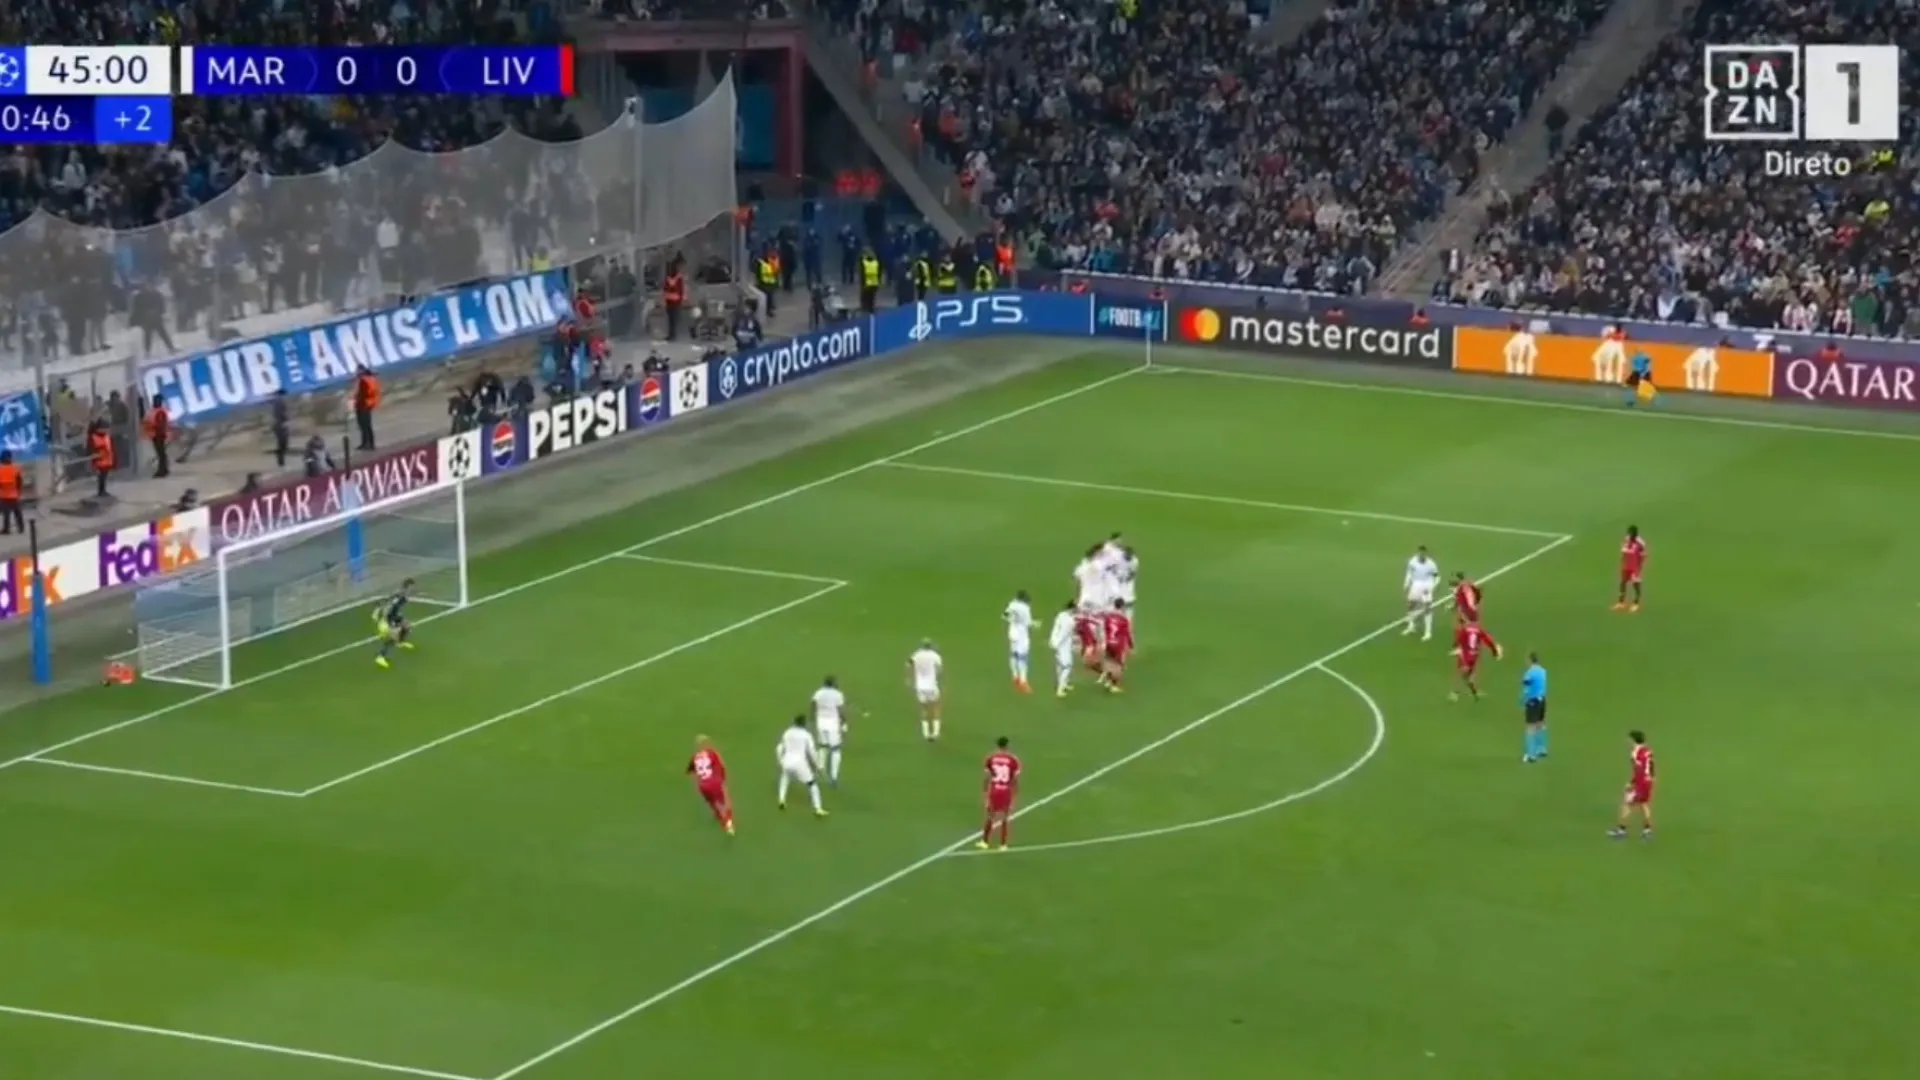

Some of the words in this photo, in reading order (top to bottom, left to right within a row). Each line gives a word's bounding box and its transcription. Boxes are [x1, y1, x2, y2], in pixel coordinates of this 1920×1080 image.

[936, 296, 1024, 331] PS5
[1230, 315, 1440, 358] mastercard
[143, 341, 282, 421] CLUB
[309, 306, 427, 381] AMIS
[446, 275, 556, 345] L'OM
[743, 327, 862, 387] crypto.com
[1786, 358, 1916, 402] QATAR
[528, 386, 627, 460] PEPSI
[221, 484, 312, 543] QATAR
[99, 514, 199, 587] FedEx
